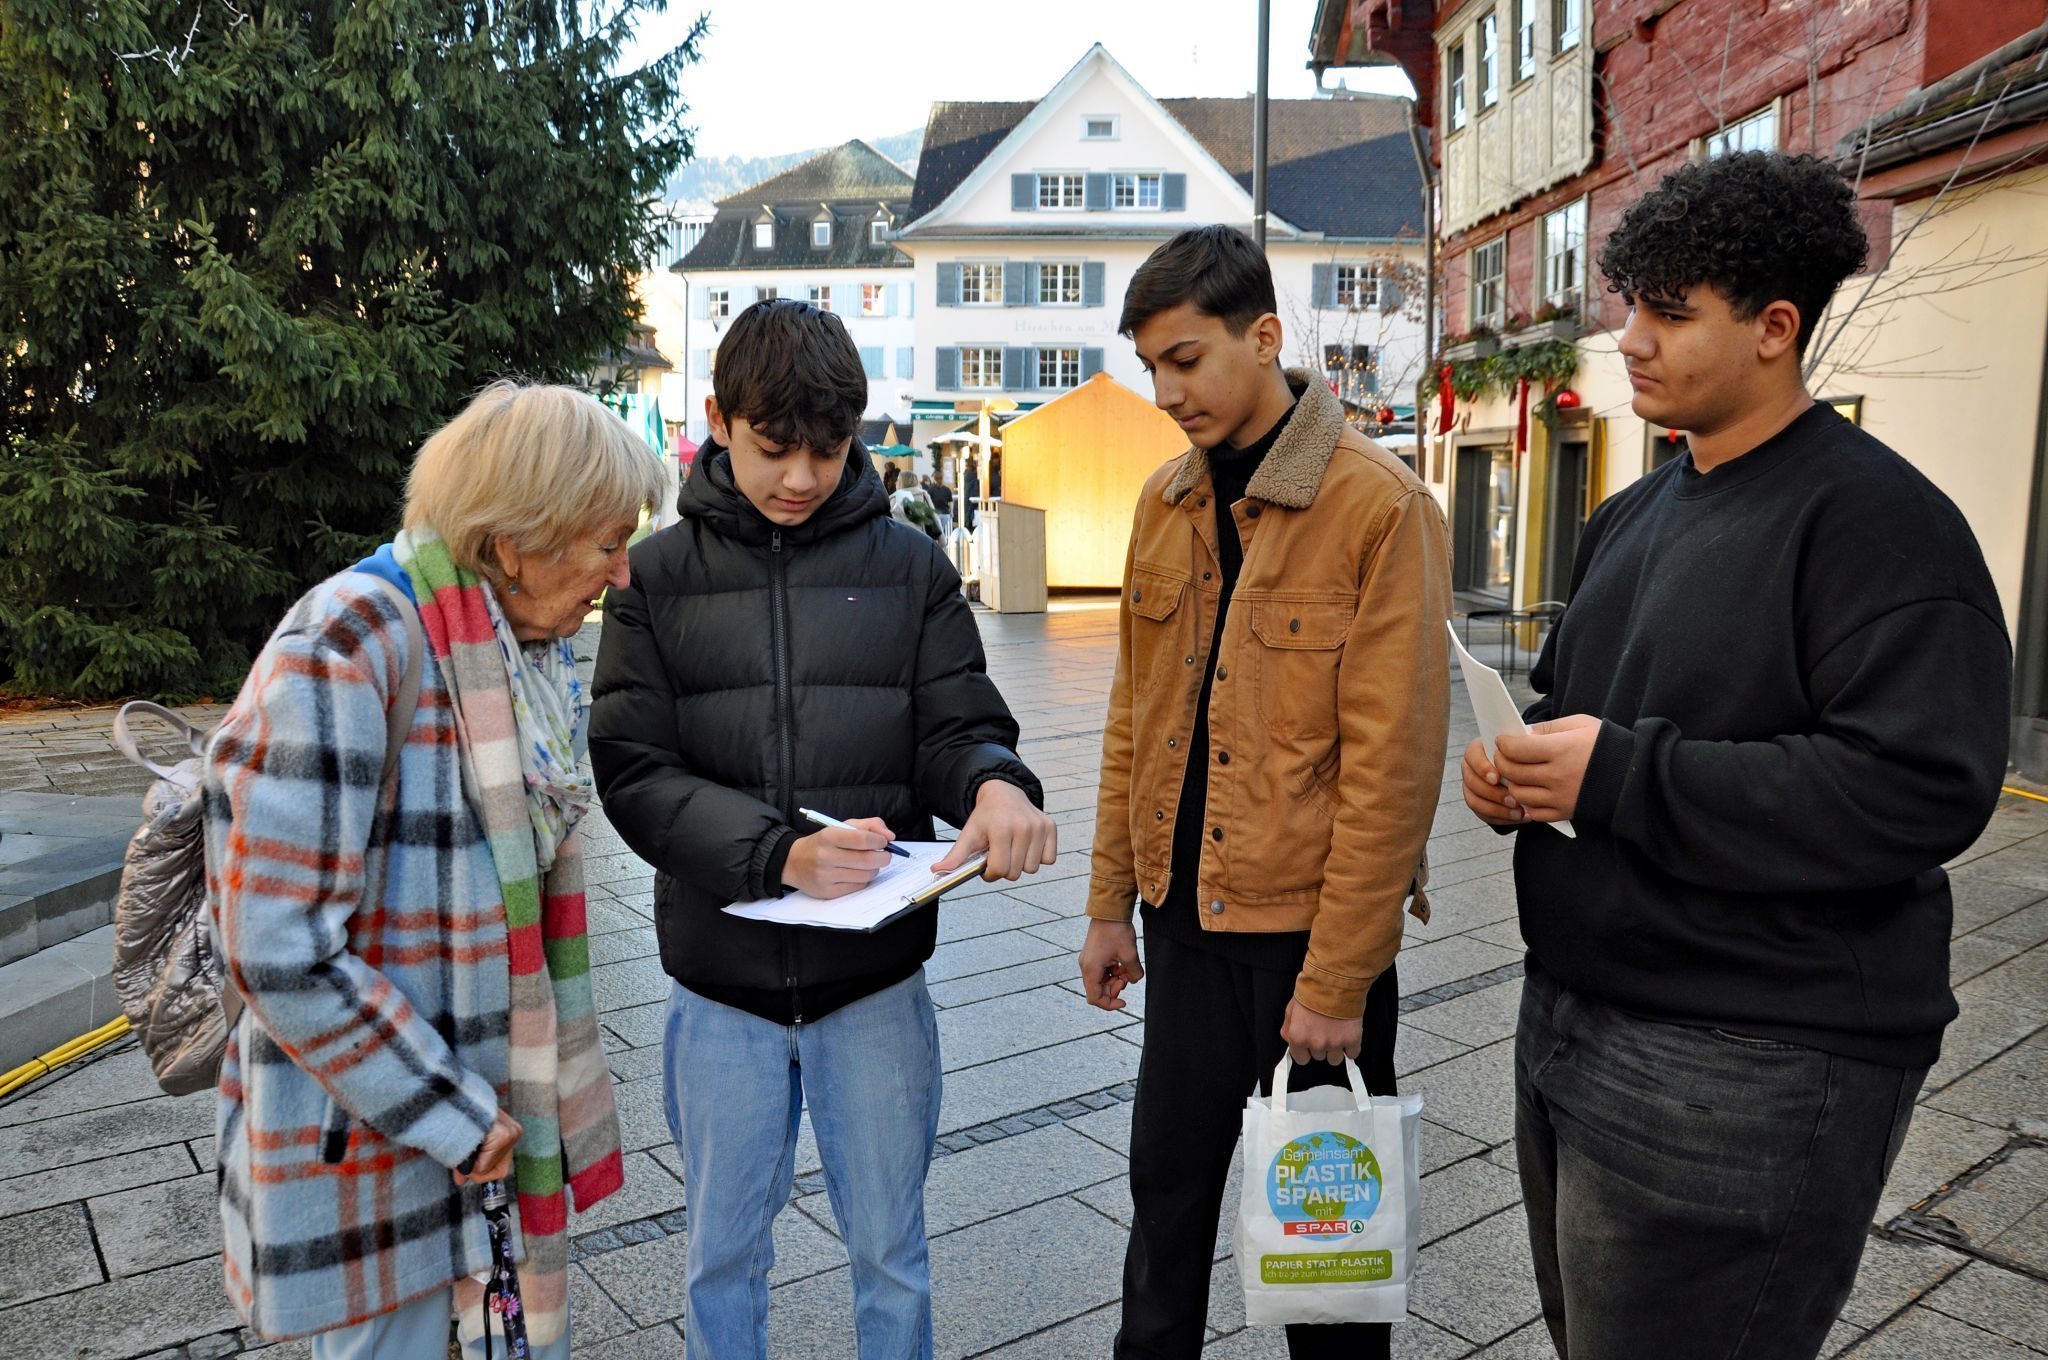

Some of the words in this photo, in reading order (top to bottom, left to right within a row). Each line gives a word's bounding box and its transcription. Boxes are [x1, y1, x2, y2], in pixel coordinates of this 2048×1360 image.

[1283, 1148, 1364, 1162] Gemeinsam
[1275, 1161, 1373, 1185] PLASTIK
[1276, 1183, 1371, 1206] SPAREN
[1315, 1207, 1334, 1217] mit
[1296, 1222, 1347, 1233] SPAR
[1266, 1260, 1303, 1270] PAPIER
[1306, 1258, 1338, 1269] STATT
[1341, 1256, 1385, 1267] PLASTIK
[1301, 1270, 1318, 1278] zum
[1320, 1267, 1370, 1279] Plastiksparen
